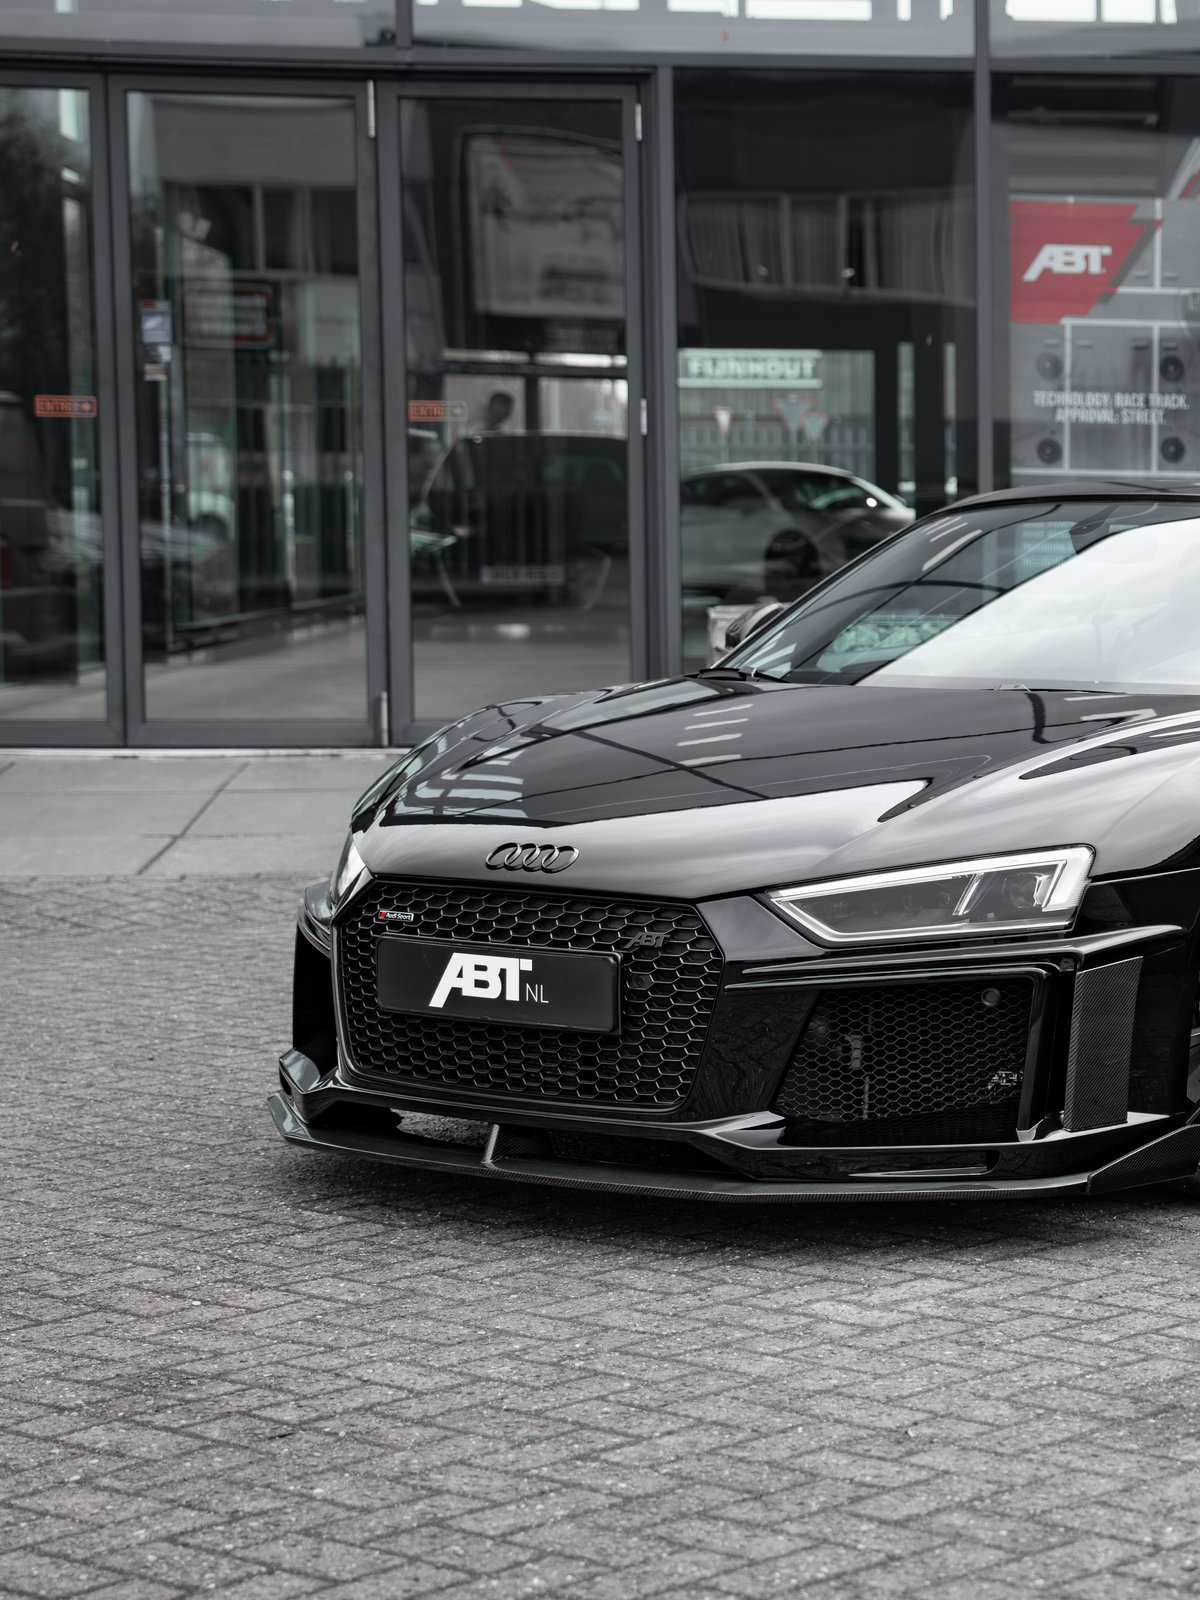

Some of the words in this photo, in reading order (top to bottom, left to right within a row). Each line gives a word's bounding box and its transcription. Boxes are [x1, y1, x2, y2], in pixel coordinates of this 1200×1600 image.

[1022, 243, 1112, 282] ABT
[1114, 392, 1146, 409] RACE
[623, 931, 671, 949] ABT
[429, 952, 533, 1008] ABT
[525, 983, 550, 1004] NL
